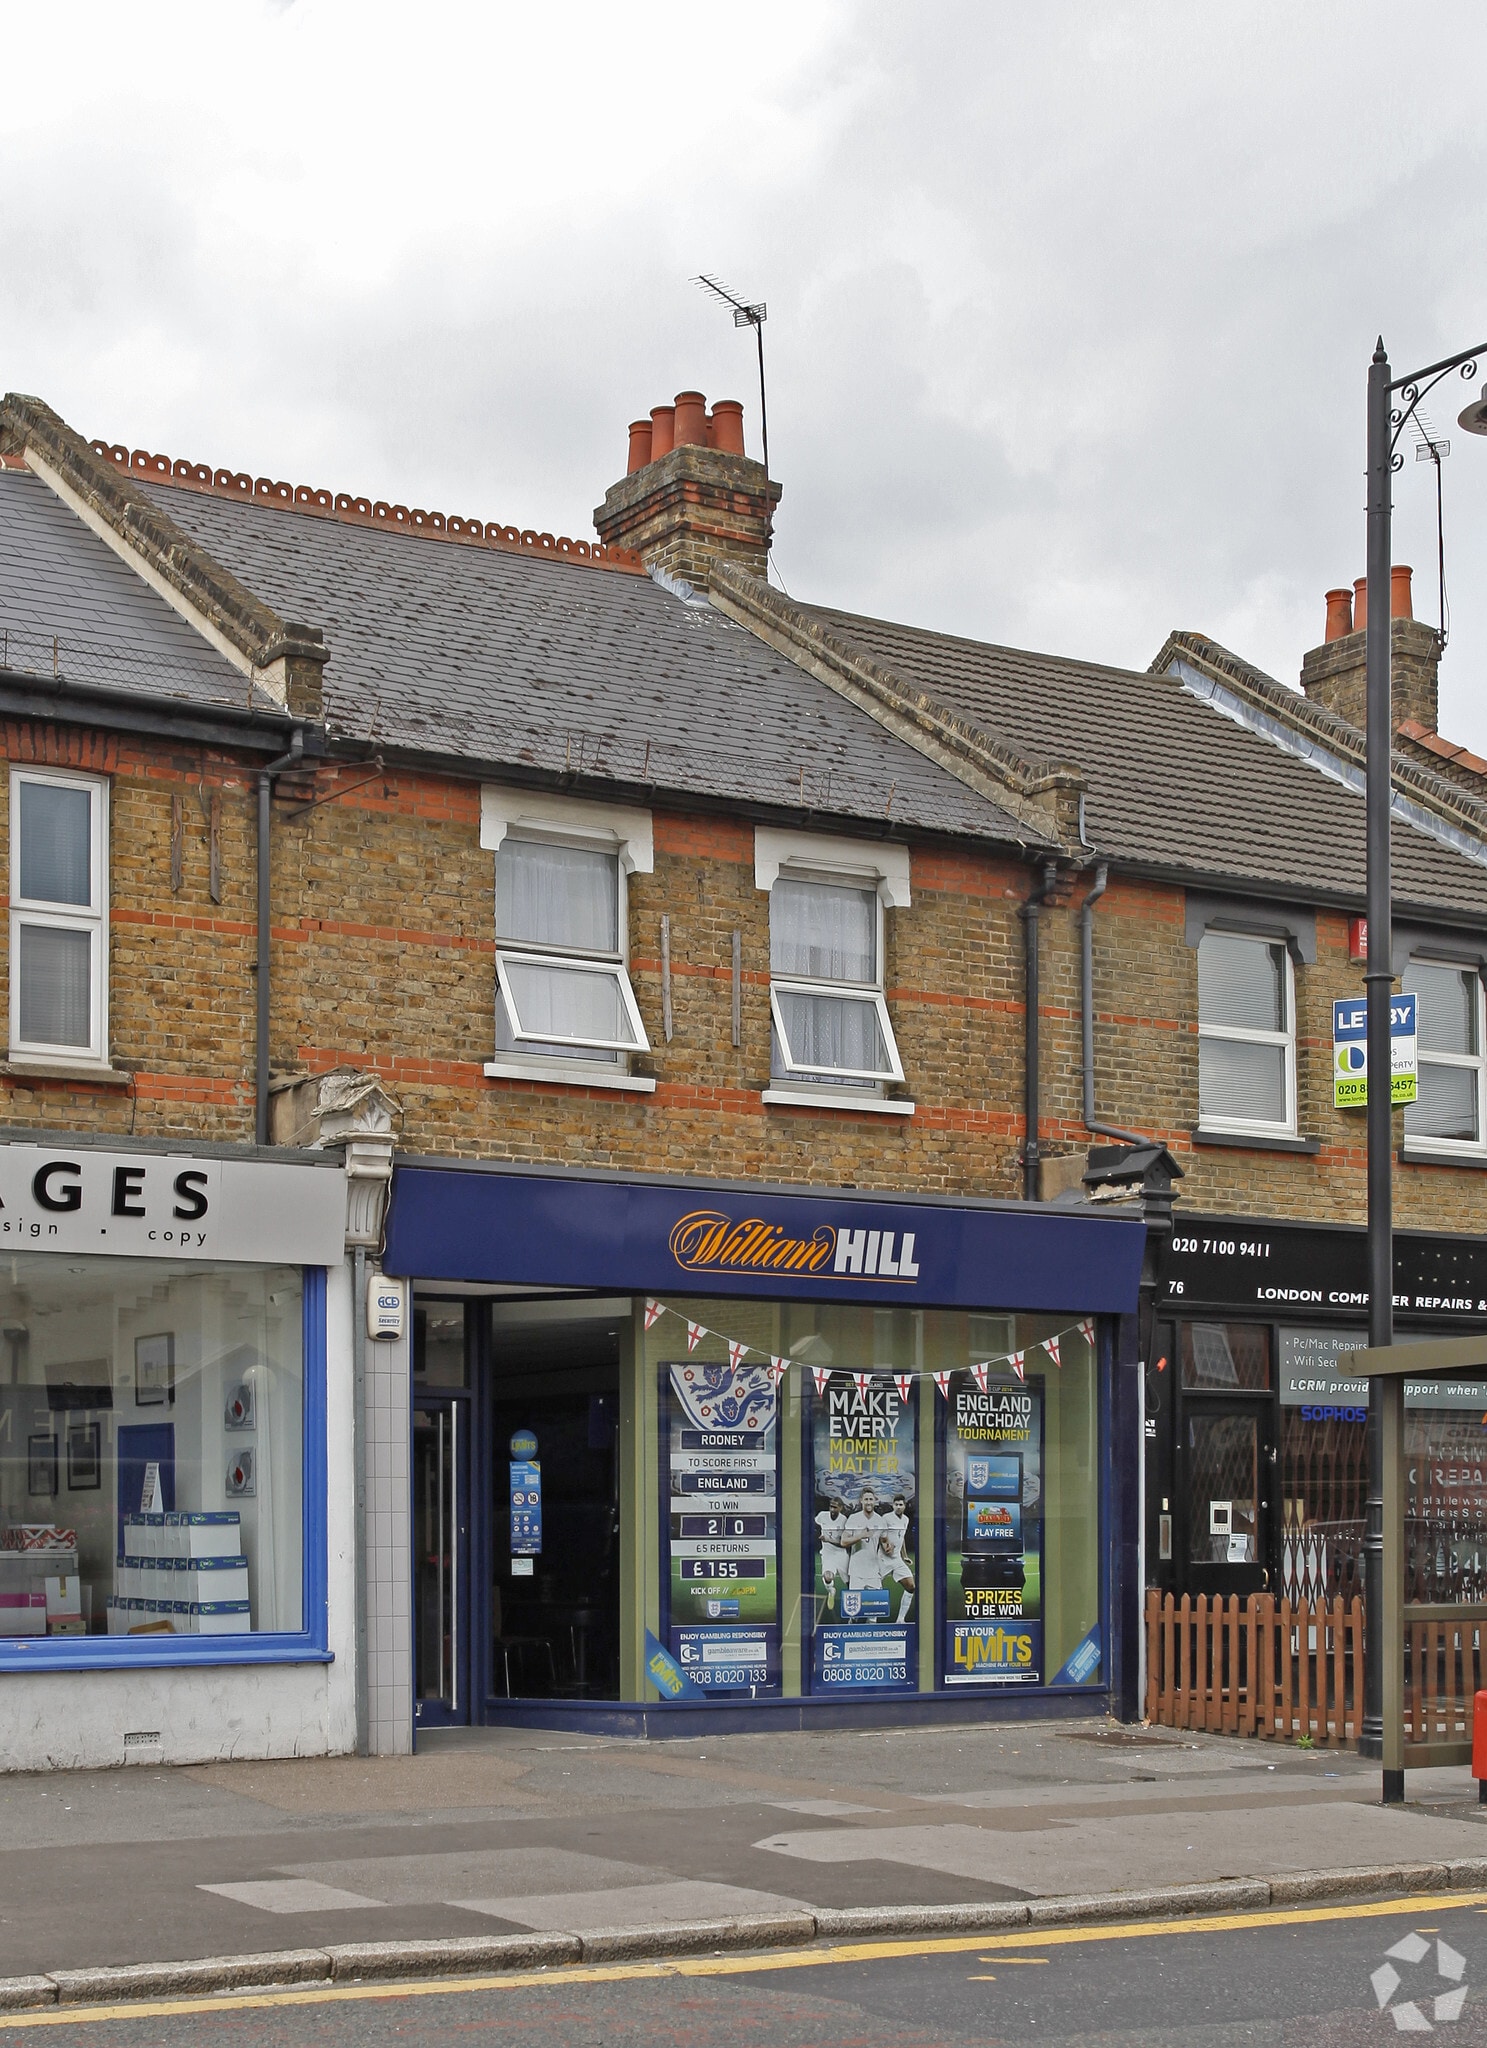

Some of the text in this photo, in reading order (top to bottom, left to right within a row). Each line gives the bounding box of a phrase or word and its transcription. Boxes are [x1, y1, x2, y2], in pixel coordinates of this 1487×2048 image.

[1339, 1085, 1357, 1095] 020
[0, 1161, 208, 1220] GES
[148, 1229, 207, 1246] copy
[669, 1210, 919, 1276] William HILL
[1172, 1238, 1271, 1257] 020 7100 9411
[1168, 1281, 1184, 1294] 76
[378, 1296, 399, 1308] ACE
[1257, 1288, 1323, 1302] LONDON
[1329, 1291, 1409, 1307] COMPER
[1415, 1296, 1472, 1310] REPAIRS
[379, 1318, 400, 1326] Security
[1293, 1337, 1367, 1352] Pc/Mac Repairs
[1294, 1355, 1315, 1367] Wifi
[1290, 1380, 1326, 1393] LCRM
[1404, 1384, 1439, 1397] pport
[1447, 1384, 1478, 1396] when
[829, 1391, 899, 1416] MAKE
[956, 1394, 1031, 1412] ENGLAND
[956, 1413, 1031, 1428] MATCHDAY
[1301, 1406, 1367, 1424] SOPHOS
[829, 1417, 900, 1438] EVERY
[957, 1427, 1030, 1441] TOURNAMENT
[701, 1435, 745, 1445] ROONEY
[829, 1439, 898, 1454] MOMENT
[689, 1458, 758, 1467] TO SCORE FIRST
[829, 1457, 898, 1473] MATTER
[697, 1478, 748, 1489] ENGLAND
[709, 1501, 739, 1510] TO WIN
[708, 1519, 744, 1534] 2 0
[974, 1528, 1014, 1537] PLAY FREE
[710, 1543, 750, 1553] RETURNS
[690, 1587, 706, 1595] KICK
[708, 1587, 721, 1595] OFF
[965, 1590, 1022, 1604] 3 PRIZES
[964, 1604, 1023, 1616] TO BE WON
[680, 1632, 699, 1640] ENJOY
[954, 1627, 994, 1637] SET YOUR
[954, 1630, 1032, 1668] LIMITS
[684, 1669, 767, 1684] 808 8020 133
[823, 1666, 906, 1682] 0808 8020 133
